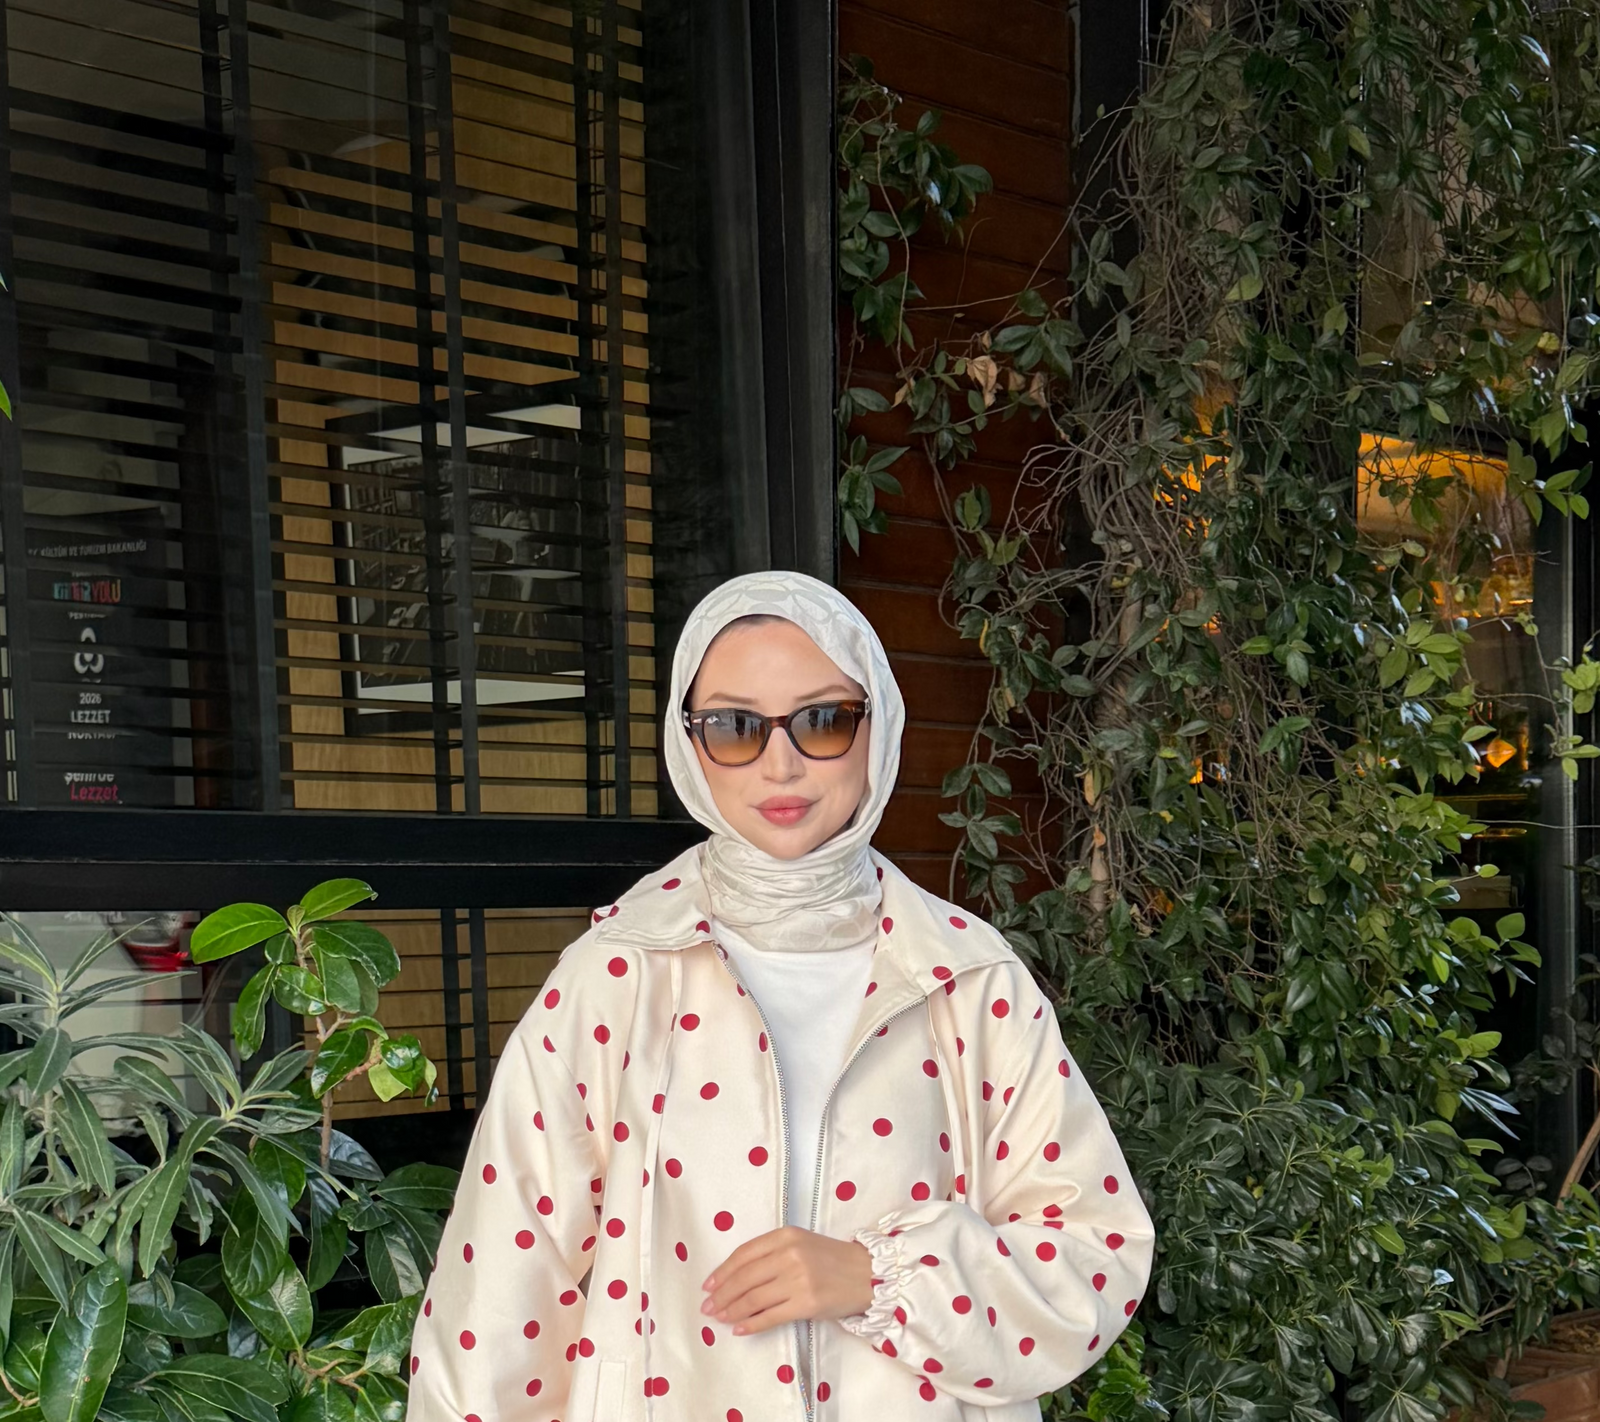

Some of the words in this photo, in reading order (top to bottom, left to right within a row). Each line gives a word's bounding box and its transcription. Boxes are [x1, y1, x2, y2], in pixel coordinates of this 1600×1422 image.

[92, 578, 122, 604] YOLU
[70, 709, 111, 724] LEZZET
[69, 783, 119, 801] Lezzet
